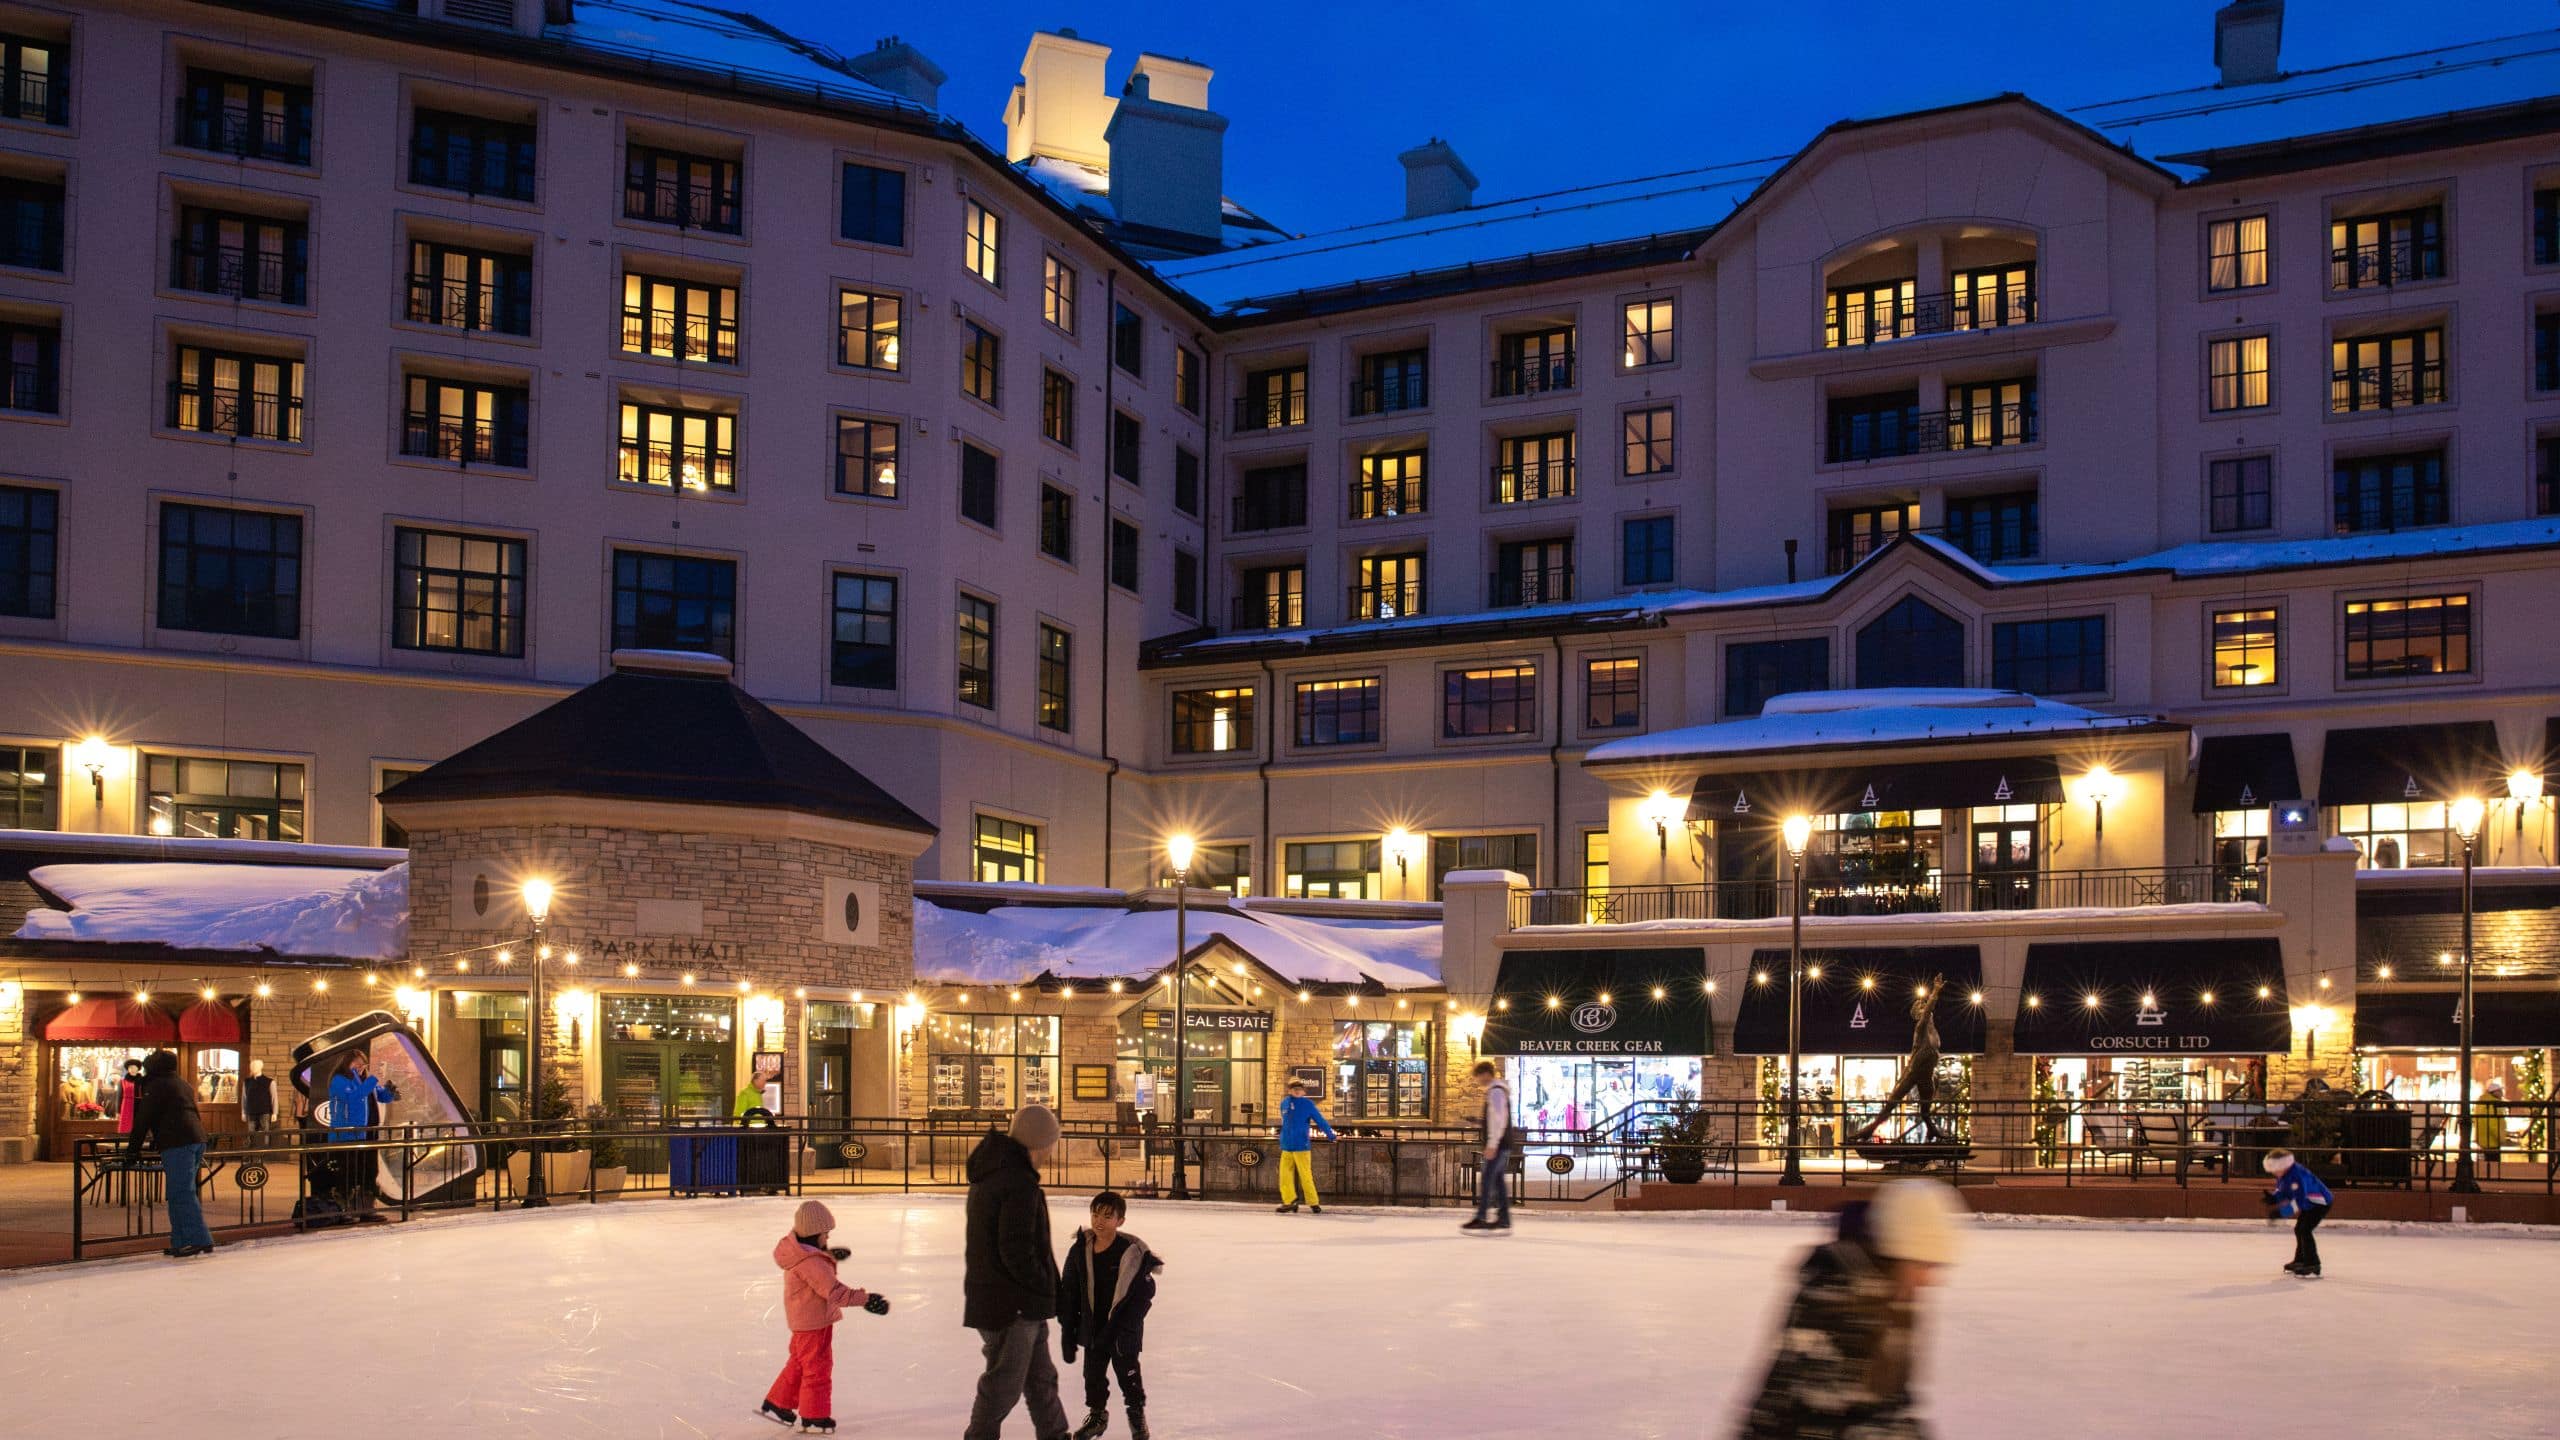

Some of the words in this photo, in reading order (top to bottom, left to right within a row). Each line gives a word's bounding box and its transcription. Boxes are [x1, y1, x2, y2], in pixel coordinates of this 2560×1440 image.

[591, 938, 655, 959] PARK
[668, 942, 748, 963] HYATT
[1183, 1015, 1214, 1027] EAL
[1218, 1016, 1270, 1029] ESTATE
[1520, 1040, 1571, 1052] BEAVER
[1576, 1040, 1620, 1052] CREEK
[1624, 1040, 1663, 1052] GEAR
[2090, 1036, 2169, 1049] GORSUCH
[2179, 1035, 2210, 1048] LTD
